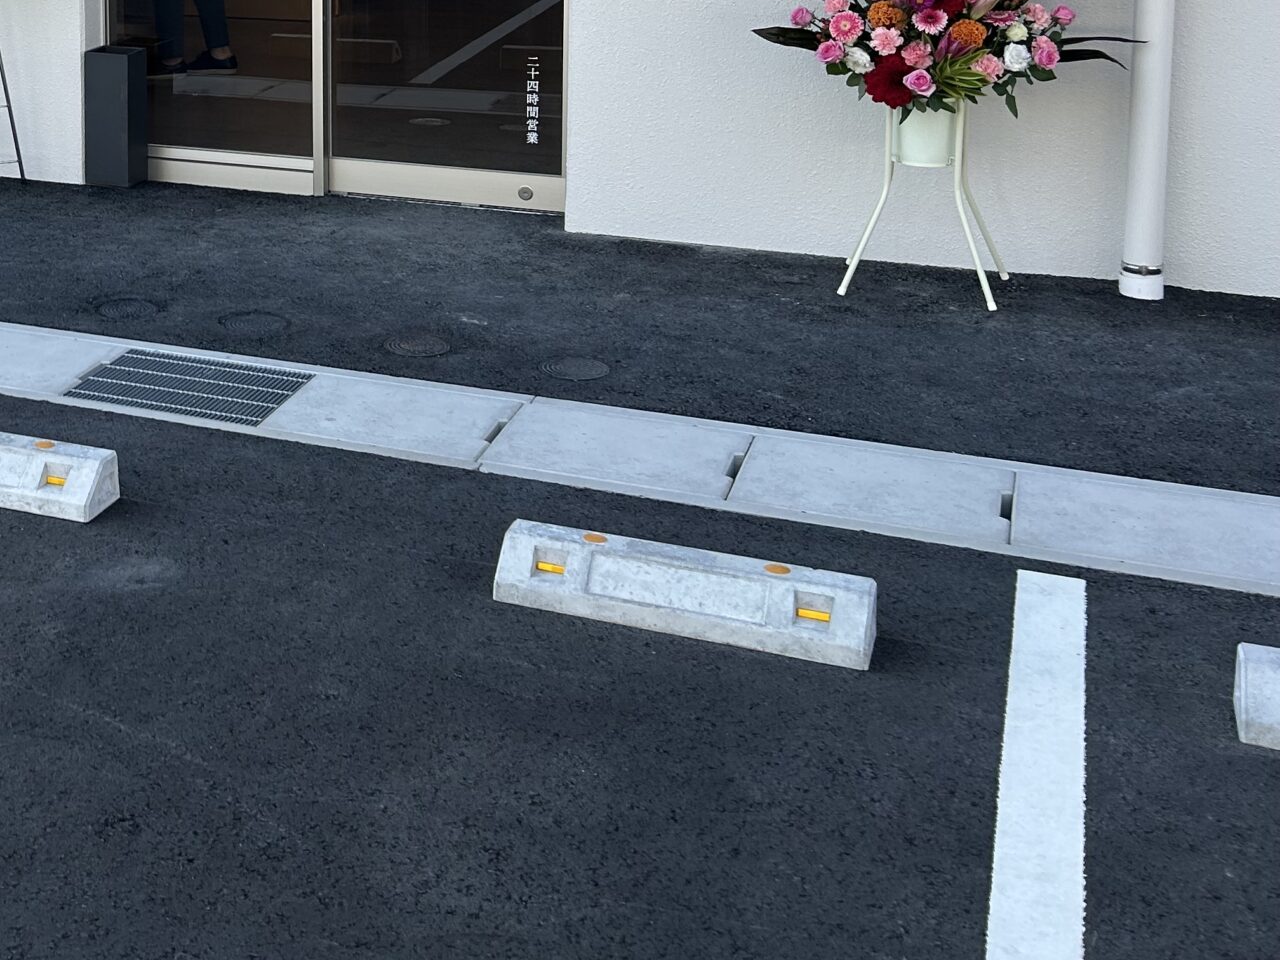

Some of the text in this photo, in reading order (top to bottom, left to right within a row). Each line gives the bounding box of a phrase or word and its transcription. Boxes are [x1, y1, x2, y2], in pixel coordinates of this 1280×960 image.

[526, 56, 540, 144] 二十四時間営業
